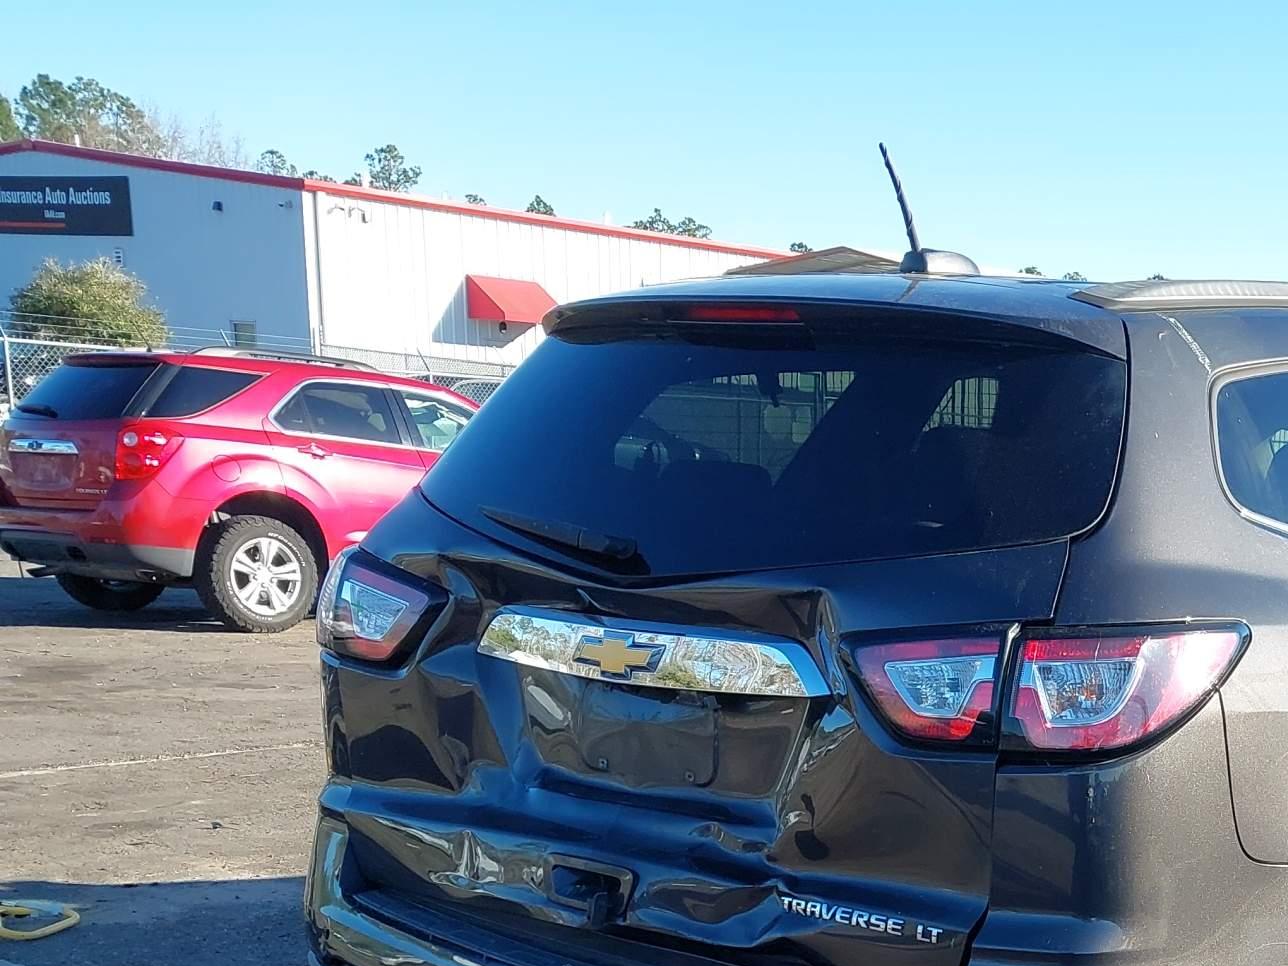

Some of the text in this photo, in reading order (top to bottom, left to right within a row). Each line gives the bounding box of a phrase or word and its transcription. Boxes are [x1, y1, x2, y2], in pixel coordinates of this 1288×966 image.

[45, 187, 66, 204] Auto
[69, 187, 111, 204] Auctions
[781, 896, 943, 944] TRAVERSE LT
